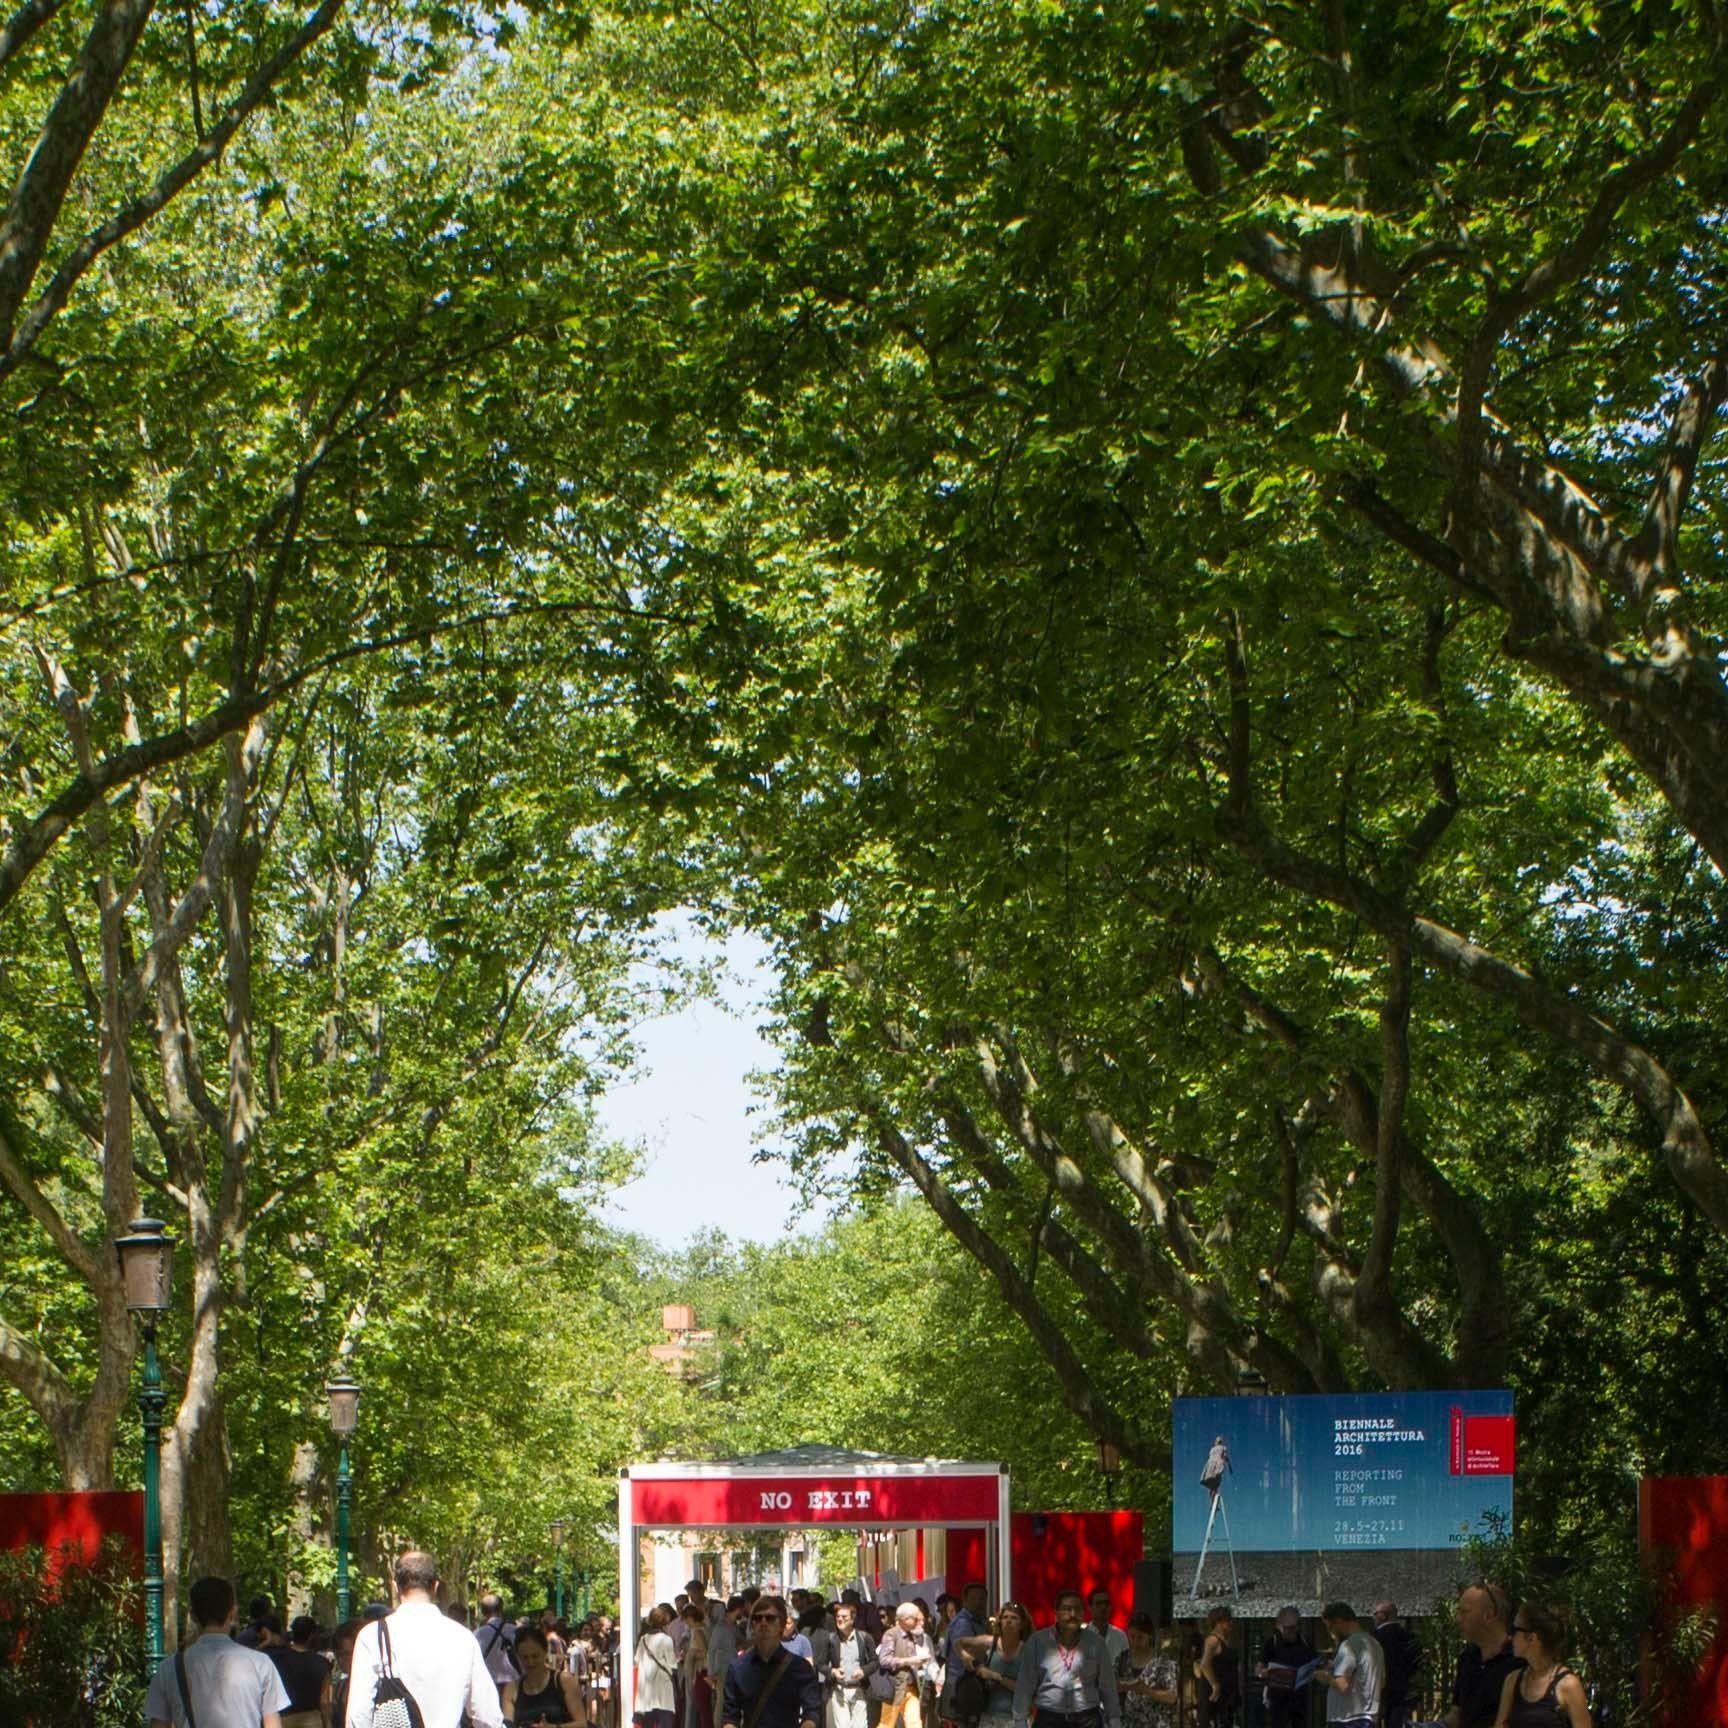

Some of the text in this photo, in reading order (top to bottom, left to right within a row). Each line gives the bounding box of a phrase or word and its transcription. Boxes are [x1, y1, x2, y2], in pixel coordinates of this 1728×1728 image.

[1334, 1419, 1394, 1430] BIENNALE
[1334, 1431, 1425, 1442] ARCHITETTURA
[1334, 1444, 1363, 1455] 2016
[1334, 1470, 1403, 1481] REPORTING
[1335, 1483, 1365, 1494] FROM
[760, 1490, 871, 1509] NO EXIT
[1335, 1495, 1398, 1506] THE FRONT
[1334, 1520, 1404, 1531] 28.5-27.11
[1334, 1533, 1386, 1545] VENEZIA
